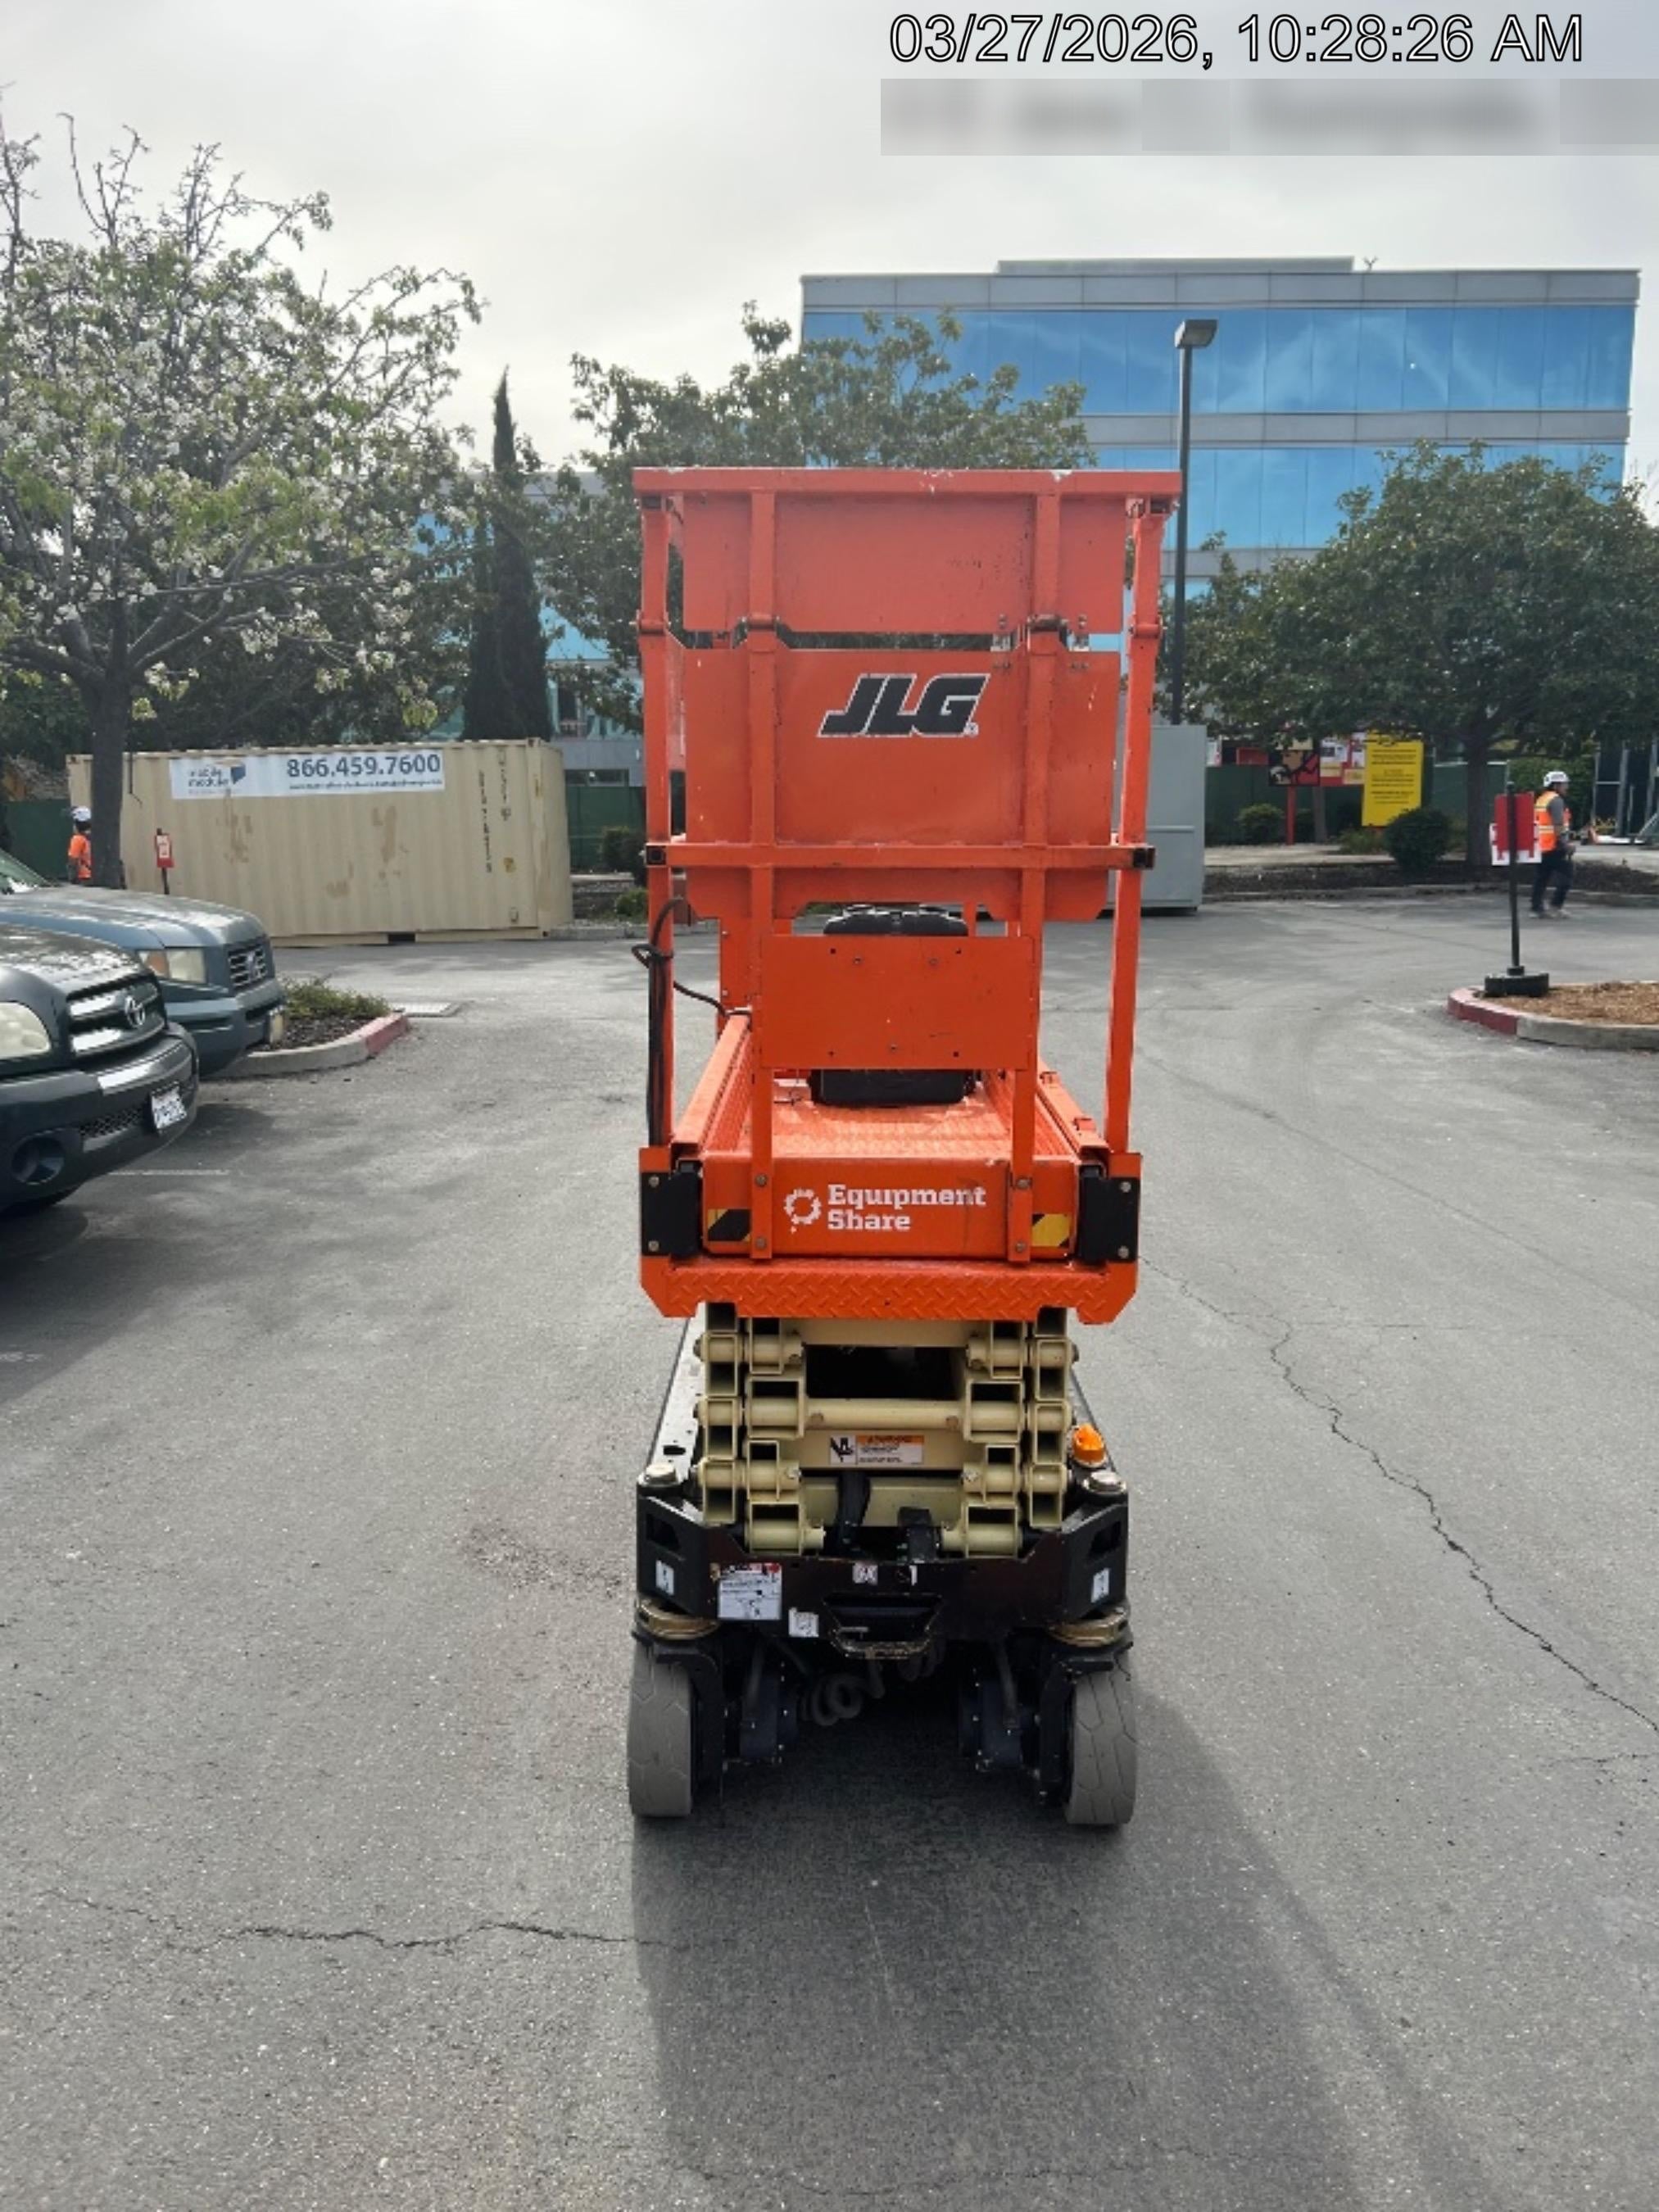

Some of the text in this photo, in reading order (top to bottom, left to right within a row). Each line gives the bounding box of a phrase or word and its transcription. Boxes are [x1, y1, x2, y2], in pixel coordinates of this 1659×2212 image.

[818, 673, 990, 737] JLG
[287, 754, 441, 777] 866.459.7600
[827, 1184, 986, 1209] Equipment
[827, 1208, 911, 1231] Share
